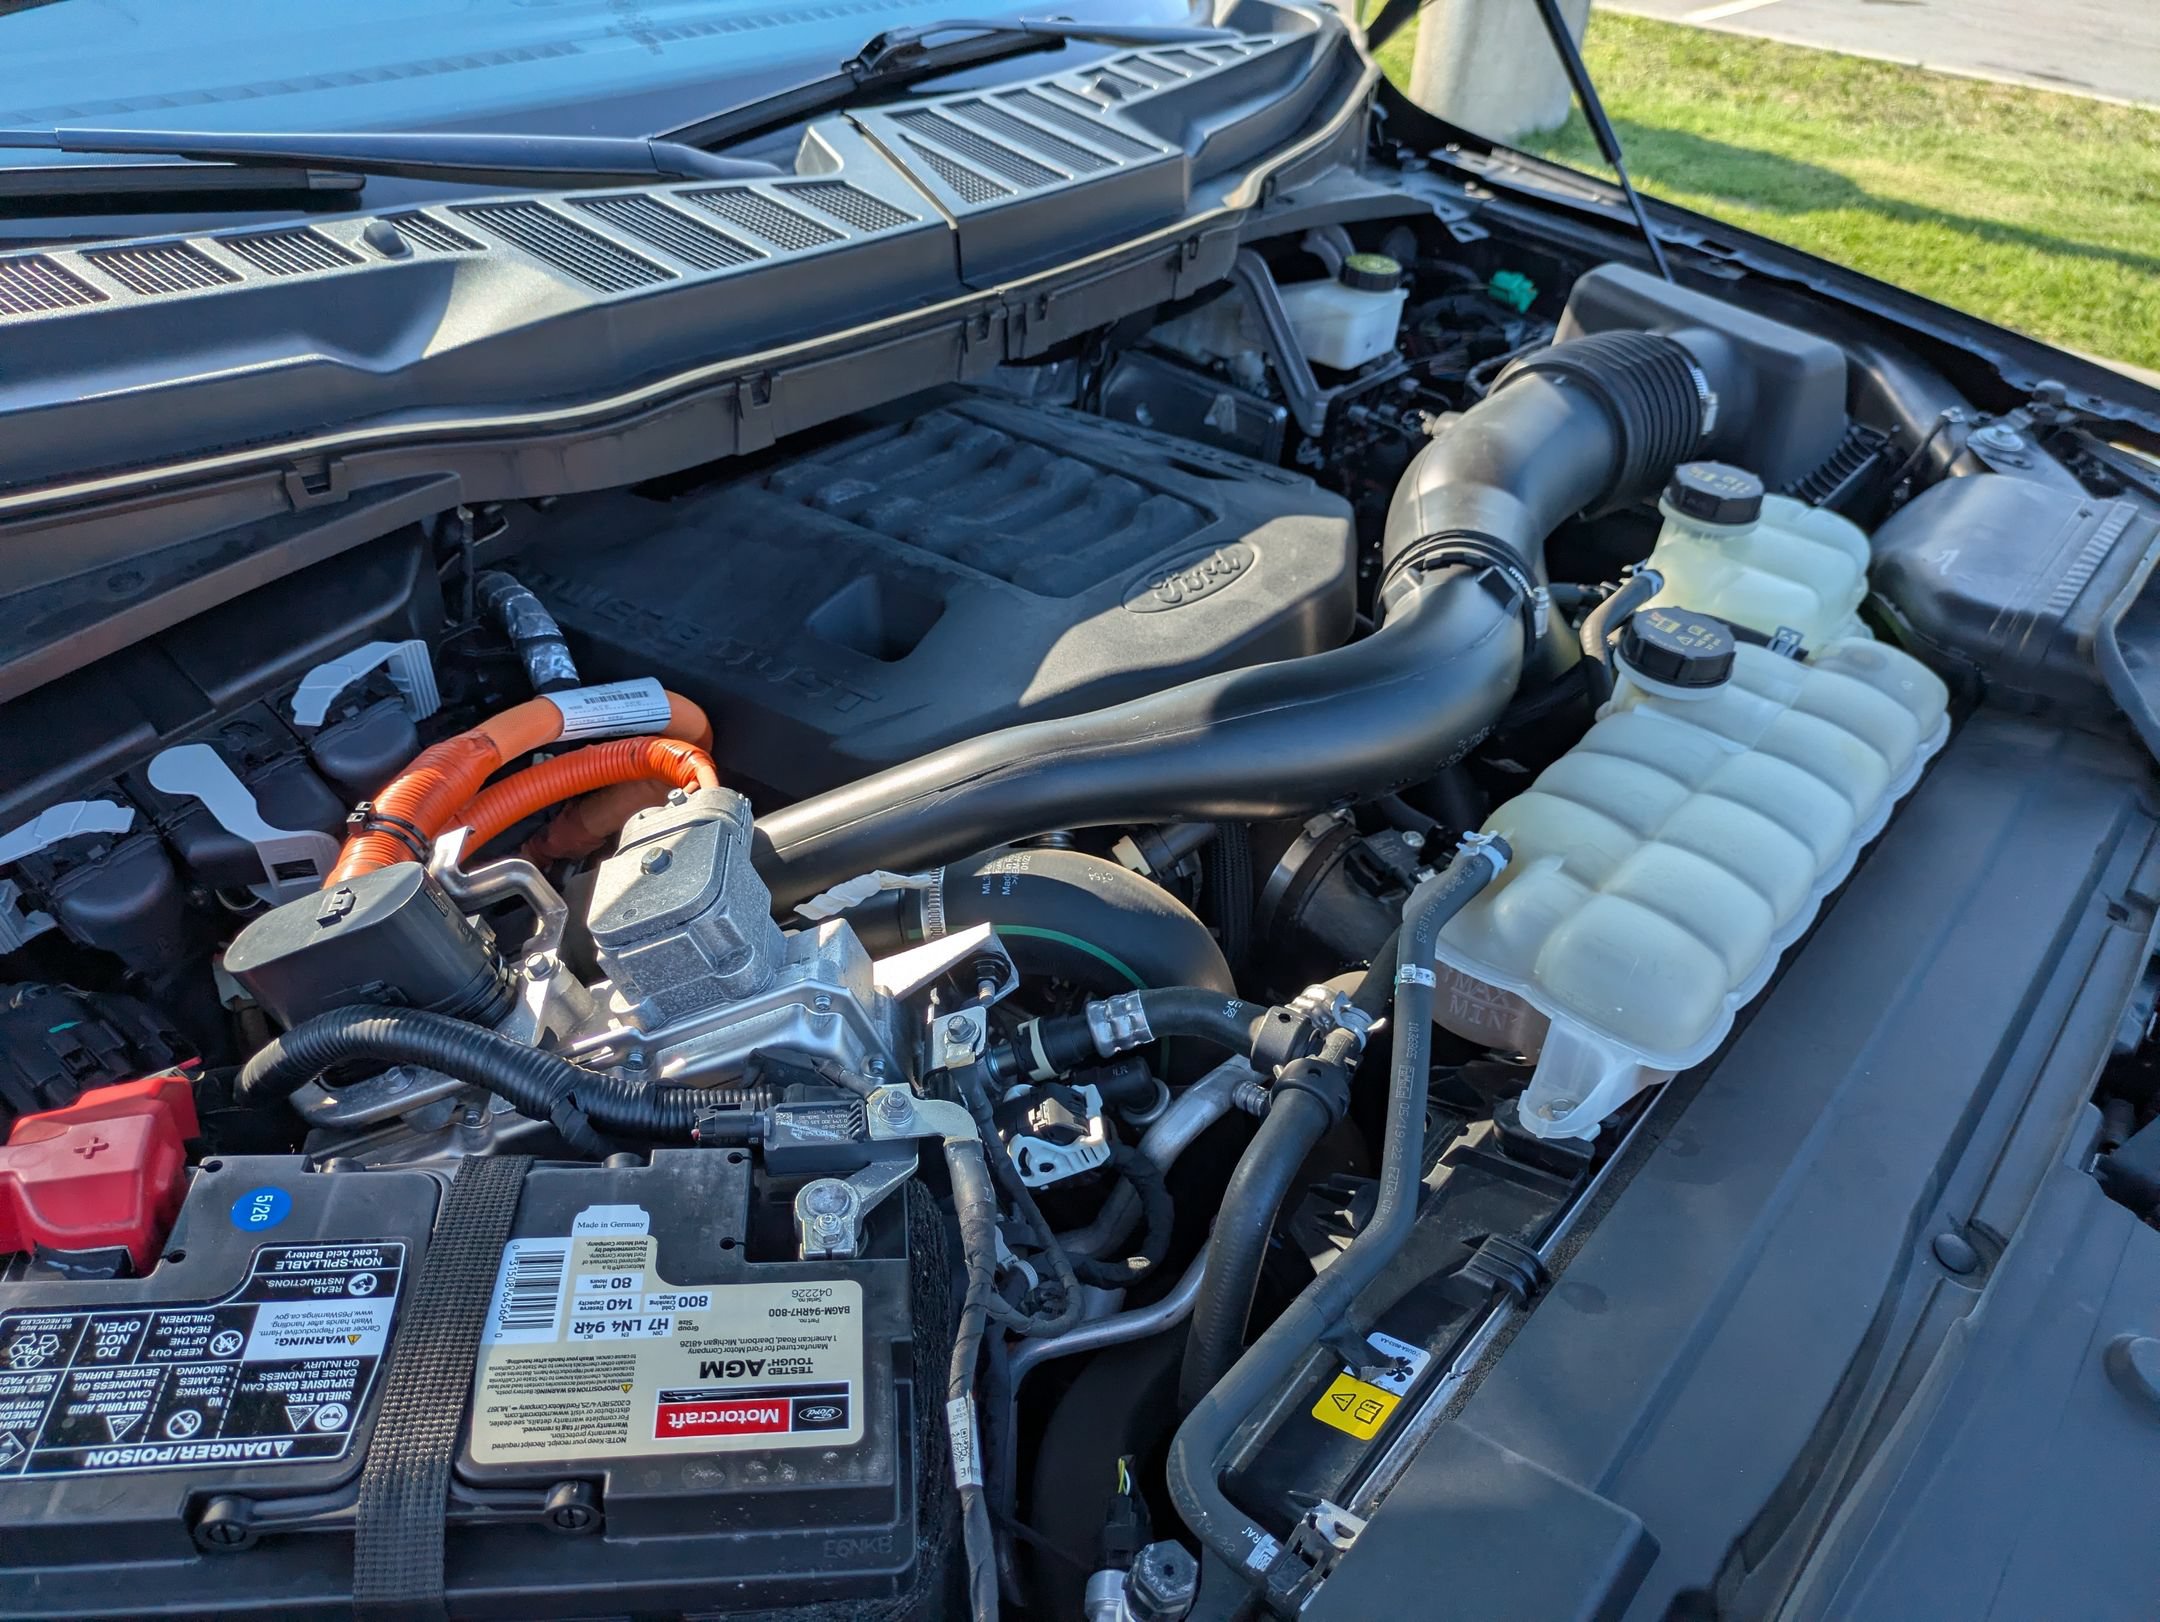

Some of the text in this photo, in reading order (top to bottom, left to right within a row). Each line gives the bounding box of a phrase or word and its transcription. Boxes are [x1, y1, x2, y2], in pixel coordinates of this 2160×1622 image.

[1144, 550, 1241, 604] Ford
[1455, 974, 1510, 1008] MAX
[1448, 995, 1508, 1031] MIN
[250, 1194, 274, 1222] 5/26
[610, 1219, 644, 1229] Germany
[585, 1239, 614, 1247] Company.
[284, 1248, 378, 1259] Lead Acid Battery
[274, 1256, 382, 1270] NON-SPILLABLE
[504, 1260, 518, 1288] 31508
[264, 1276, 344, 1287] INSTRUCTIONS.
[610, 1276, 631, 1288] 80
[312, 1285, 342, 1293] READ
[791, 1287, 832, 1298] 042226
[497, 1291, 512, 1321] 64566
[606, 1297, 632, 1310] 140
[648, 1298, 676, 1306] Cranking
[678, 1295, 708, 1307] 800
[768, 1305, 849, 1317] BAGM-94RH7-800
[159, 1313, 214, 1324] CHILDREN.
[270, 1319, 305, 1328] handling.
[678, 1318, 692, 1326] Size
[94, 1320, 140, 1332] OPEN.
[155, 1325, 211, 1335] REACH OF
[283, 1325, 334, 1335] Reproductive
[352, 1324, 380, 1332] Cancer
[573, 1317, 668, 1334] H7 LN4 94R
[677, 1324, 698, 1332] Group
[258, 1329, 282, 1337] Harm.
[797, 1334, 832, 1343] American
[94, 1334, 130, 1345] NOT
[169, 1336, 207, 1345] OF THE
[274, 1335, 346, 1346] WARNING:
[679, 1339, 702, 1348] 48126
[703, 1337, 736, 1347] Michigan
[737, 1336, 774, 1345] Dearborn,
[775, 1335, 796, 1344] Road,
[95, 1346, 120, 1357] DO
[147, 1347, 203, 1357] KEEP OUT
[687, 1342, 828, 1355] Manufactured for Ford Motor Company
[303, 1358, 359, 1368] OR INJURY.
[699, 1358, 765, 1379] AGM
[71, 1368, 160, 1380] SEVERE BURNS.
[175, 1364, 227, 1374] SMOKING
[259, 1368, 357, 1380] CAUSE BLINDNESS
[767, 1365, 813, 1375] TESTED
[71, 1379, 156, 1391] BLINDNESS OR
[178, 1375, 224, 1385] FLAMES
[240, 1378, 354, 1392] EXPLOSIVE GASES CAN
[86, 1389, 152, 1400] CAN CAUSE
[175, 1385, 220, 1396] SPARKS
[286, 1390, 351, 1402] SHIELD EYES.
[207, 1395, 223, 1406] NO
[67, 1400, 148, 1414] SULFURIC ACID
[668, 1407, 835, 1427] Ford Motorcraft
[0, 1419, 37, 1429] FLUSH
[521, 1425, 554, 1433] removed.
[595, 1420, 628, 1429] Warranty
[550, 1430, 586, 1438] protection.
[587, 1428, 616, 1436] warranty
[491, 1441, 520, 1450] required
[520, 1440, 546, 1448] Receipt
[547, 1439, 570, 1447] receipt.
[587, 1436, 604, 1444] Keep
[604, 1436, 626, 1444] NOTE:
[83, 1441, 272, 1464] DANGER/POISON
